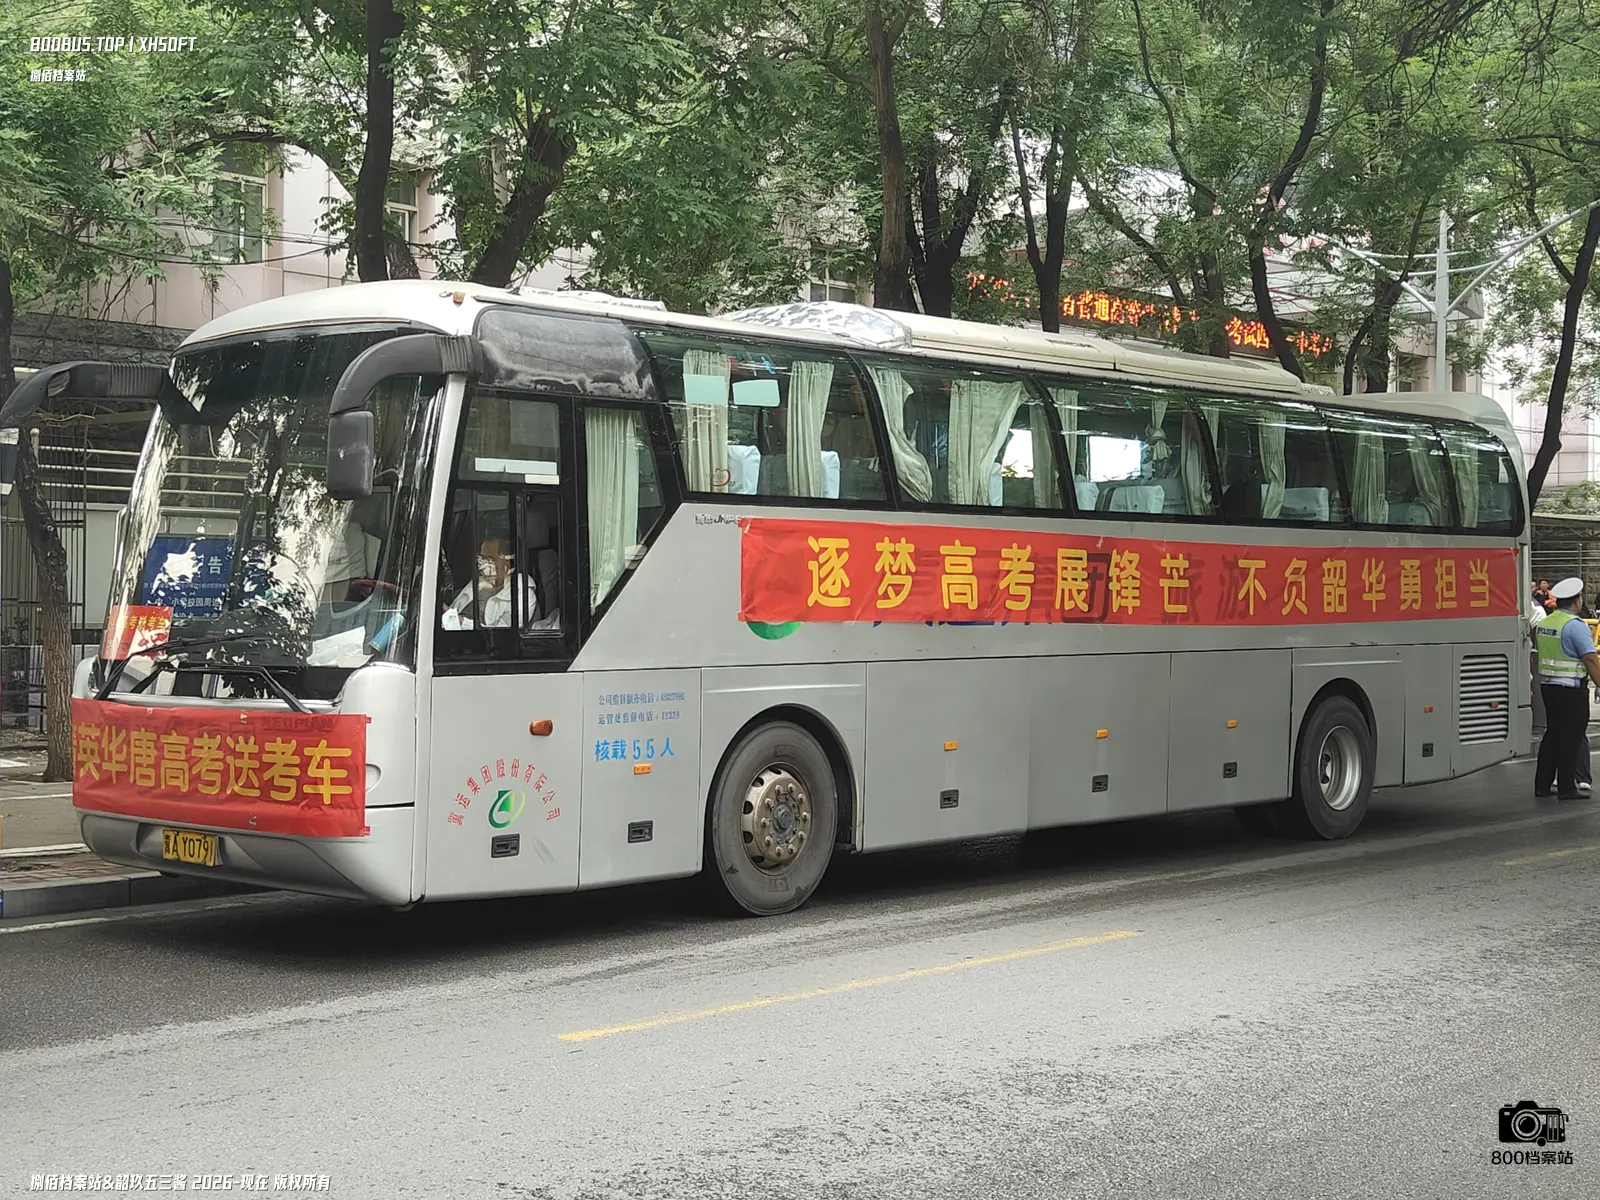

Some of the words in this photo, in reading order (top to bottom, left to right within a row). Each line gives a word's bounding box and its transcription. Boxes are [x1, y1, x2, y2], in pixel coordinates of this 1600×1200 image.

[807, 535, 1190, 616] 逐梦高考展锋芒
[1237, 556, 1490, 616] 不负韶华勇担当
